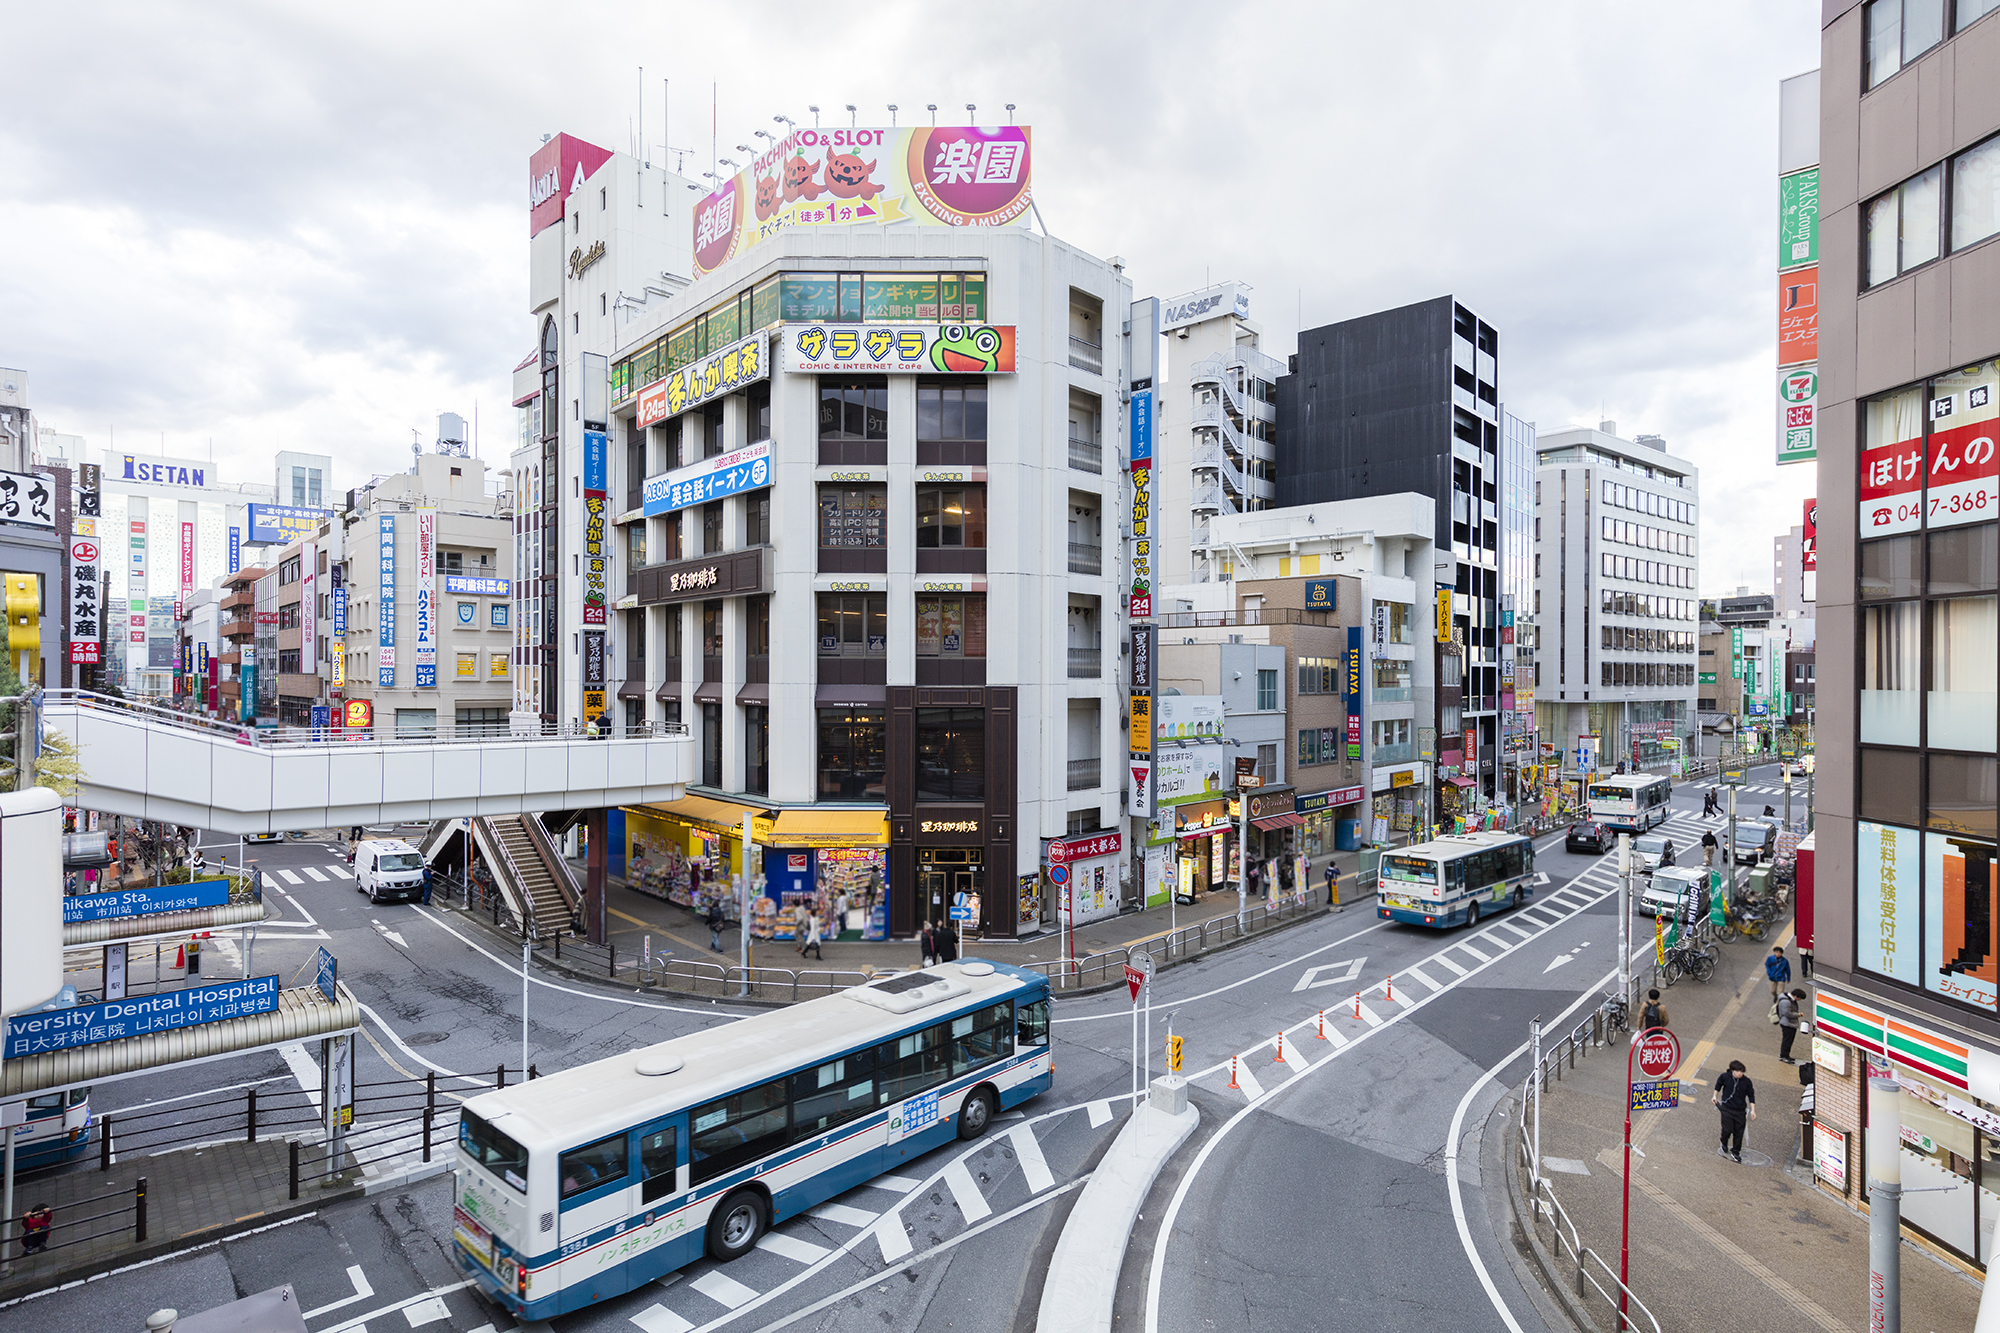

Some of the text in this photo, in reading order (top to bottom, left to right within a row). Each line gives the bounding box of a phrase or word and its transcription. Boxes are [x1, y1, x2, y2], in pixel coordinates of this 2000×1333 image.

[754, 130, 884, 177] PACHINKO & SLOT
[931, 139, 1025, 184] 楽園
[800, 202, 852, 224] 徒歩1分
[913, 181, 1031, 227] EXCITING AMUSEMEN
[696, 190, 735, 254] 楽園
[797, 327, 926, 361] ゲラゲラ
[667, 341, 759, 413] まんが喫茶
[1138, 399, 1146, 457] 英会話イーオン
[1788, 407, 1812, 426] たばこ
[1788, 429, 1811, 449] 酒
[122, 455, 204, 487] ISETAN
[592, 439, 600, 488] 英会話イーオン
[753, 465, 765, 483] 5F
[1869, 436, 1995, 487] ほけんの
[645, 479, 670, 502] AEON
[671, 467, 749, 507] 英会話イーオン
[1132, 467, 1150, 556] まんが喫茶
[420, 515, 429, 578] いい部屋ネット
[587, 497, 604, 571] まんが喫茶
[382, 519, 394, 599] 平岡歯科医院
[496, 581, 509, 594] 4F
[669, 567, 718, 592] 星乃珈琲店
[74, 564, 97, 637] 磯丸水産
[586, 608, 603, 617] 24
[1132, 599, 1149, 609] 24
[418, 589, 428, 643] ハウスコム
[72, 652, 98, 662] 時間
[73, 643, 97, 652] 24
[588, 637, 601, 682] 星乃珈琲店
[1134, 632, 1147, 684] 星乃珈琲店
[381, 675, 393, 684] 4F
[418, 674, 434, 685] 3F
[1350, 648, 1358, 695] TSUTAYA
[1132, 699, 1149, 716] 薬
[347, 717, 370, 727] Daily
[1136, 778, 1146, 809] 大都会
[1305, 797, 1326, 808] TSUTAYA
[921, 821, 978, 833] 星乃珈琲店
[1183, 814, 1230, 831] Pepper Lunch
[1088, 837, 1119, 855] 大都会
[96, 904, 132, 917] 市川站
[142, 896, 198, 912] 이치카와역
[122, 892, 152, 904] Sta.
[1880, 828, 1897, 973] 無料体験受付中!!
[110, 946, 122, 990] 松戸駅
[1128, 972, 1141, 985] 止まれ
[104, 993, 180, 1020] Dental
[189, 979, 275, 1006] Hospital
[14, 995, 272, 1054] 日大牙科医院 니치다이 치과병원
[1006, 1058, 1019, 1068] 3384
[1641, 1047, 1672, 1065] 消火栓
[1633, 1088, 1678, 1103] かとれあ眼科
[560, 1238, 588, 1256] 3384
[597, 1217, 685, 1265] ノンステップバス
